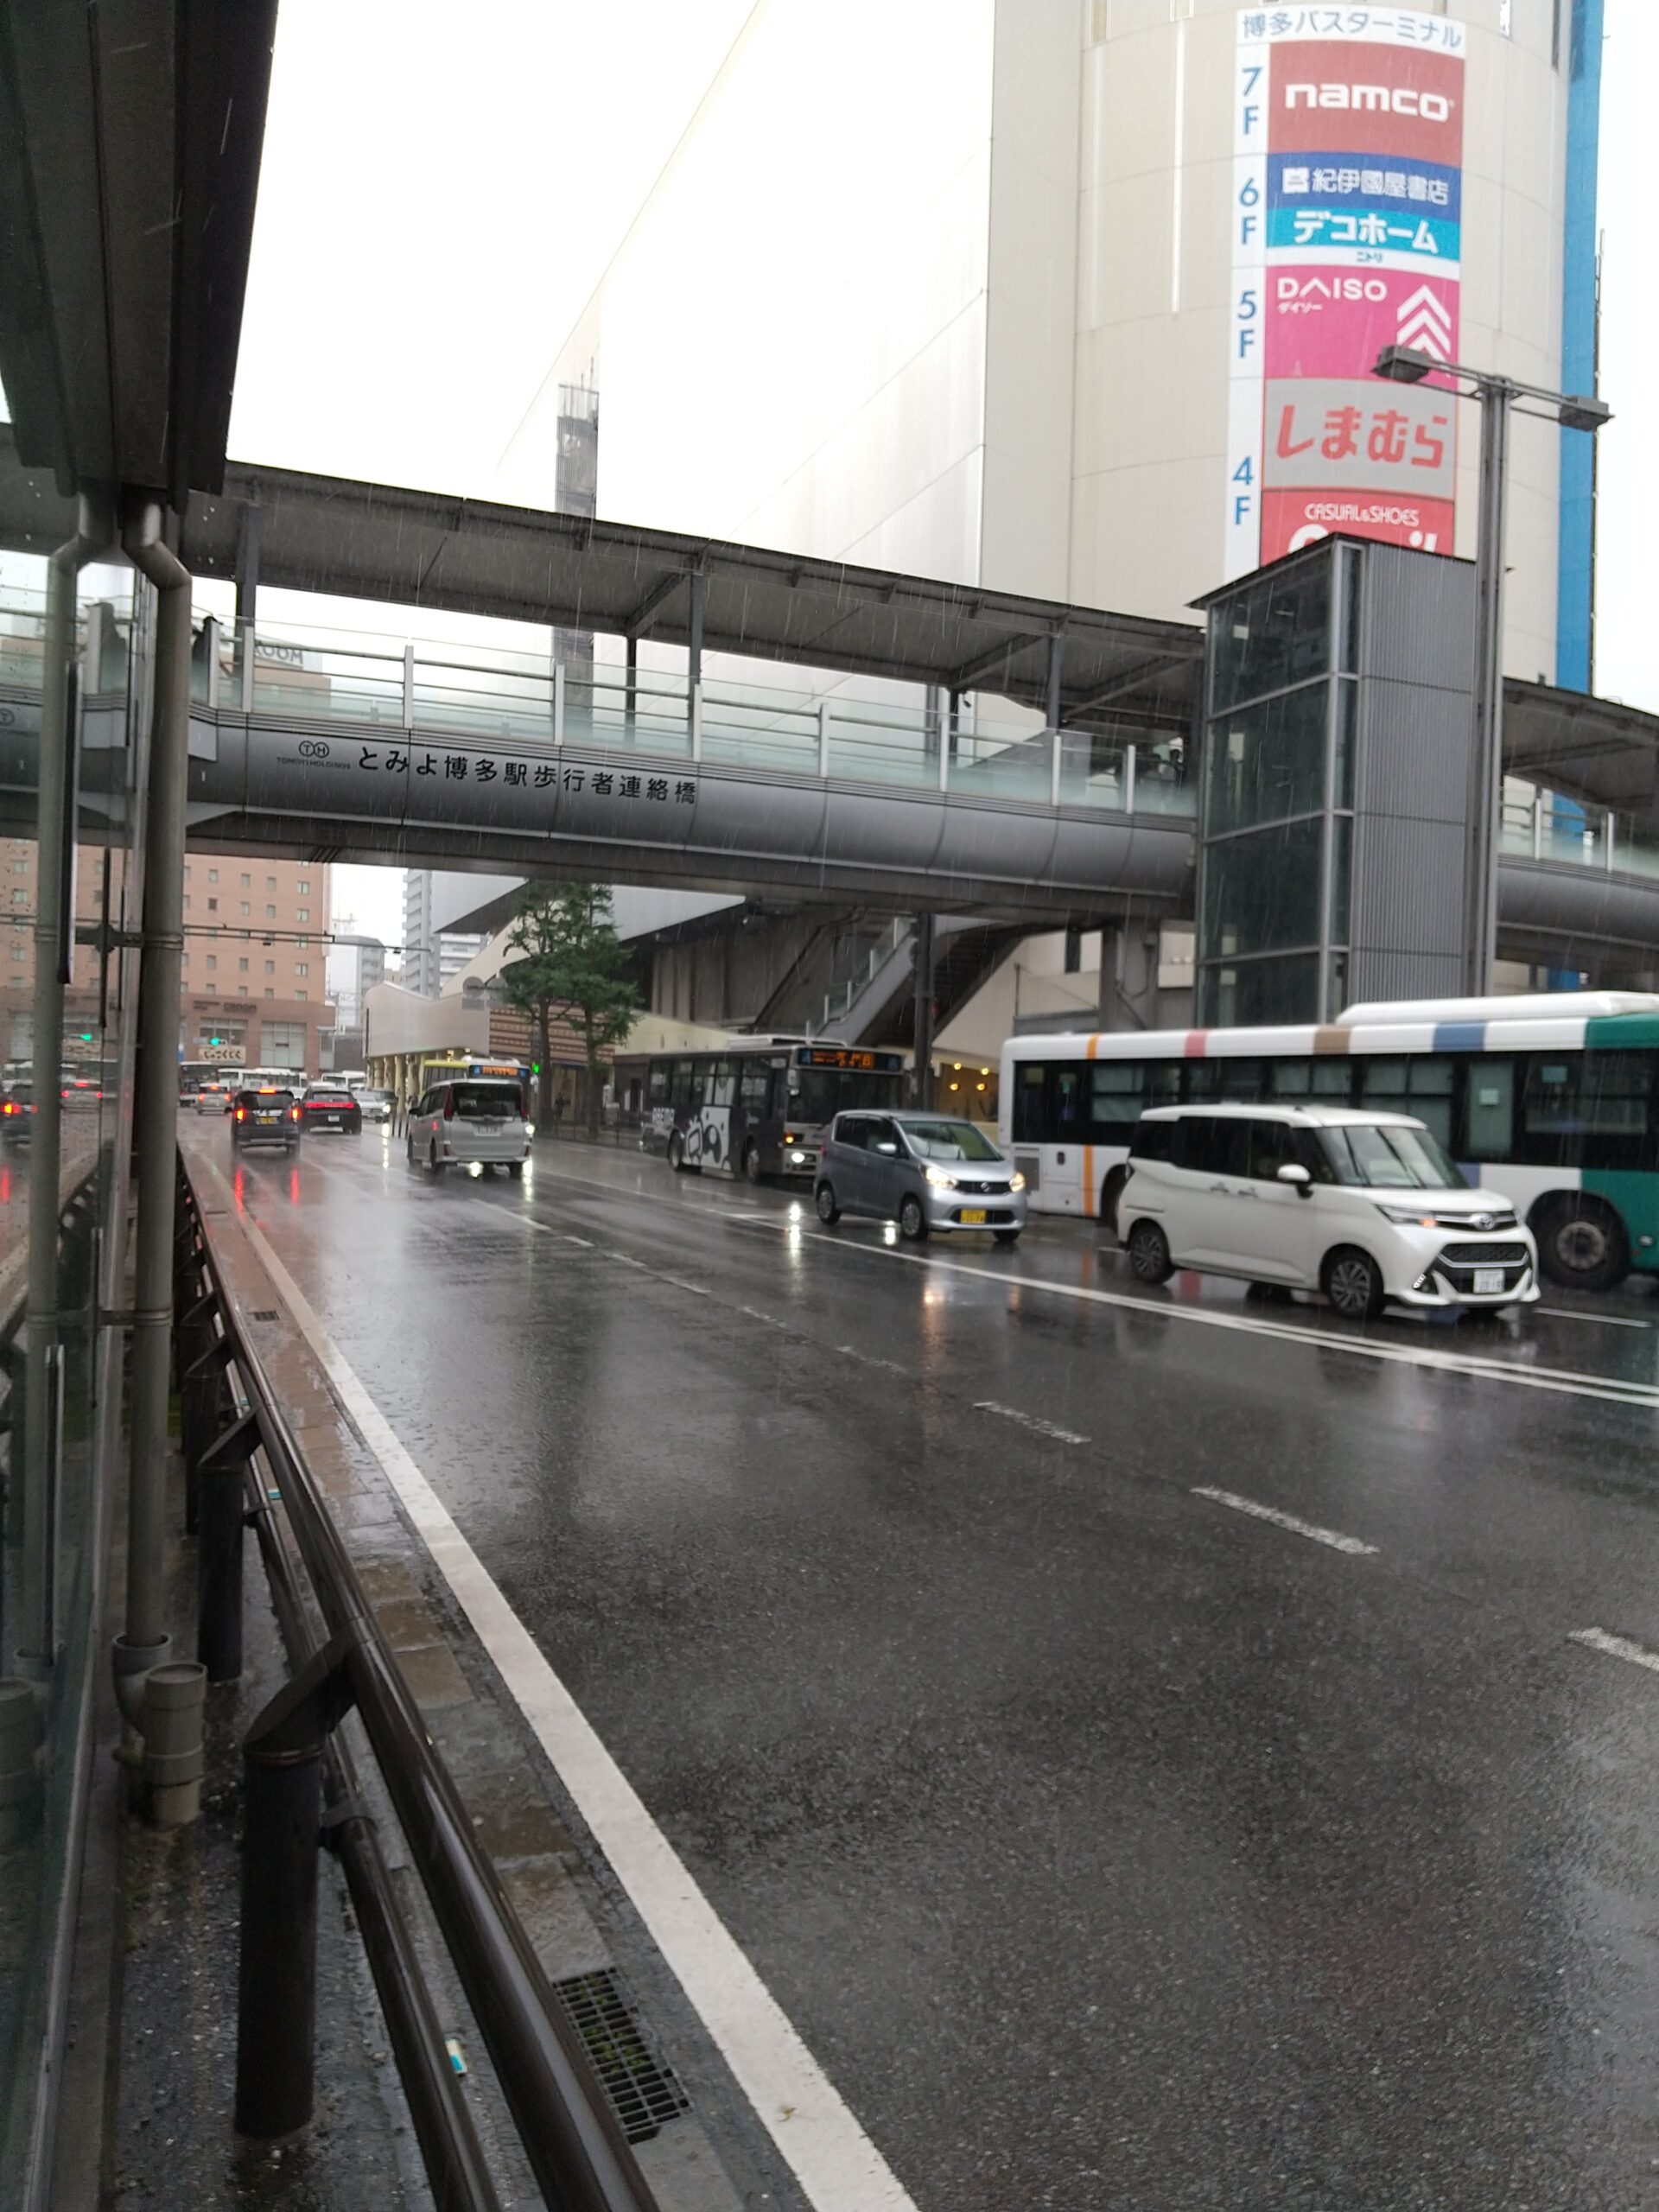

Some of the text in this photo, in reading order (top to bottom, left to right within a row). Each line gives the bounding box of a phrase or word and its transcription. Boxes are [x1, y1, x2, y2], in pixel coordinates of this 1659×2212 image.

[1243, 11, 1463, 48] 博多バスターミナル
[1285, 83, 1450, 123] namco
[1313, 168, 1450, 206] 紀伊國屋書店
[1294, 211, 1439, 254] デコホーム
[1277, 276, 1388, 302] DAISO
[1278, 302, 1323, 314] ダイソー
[1276, 404, 1448, 469] しまむら
[359, 747, 696, 804] とみよ博多駅歩行者連絡橋
